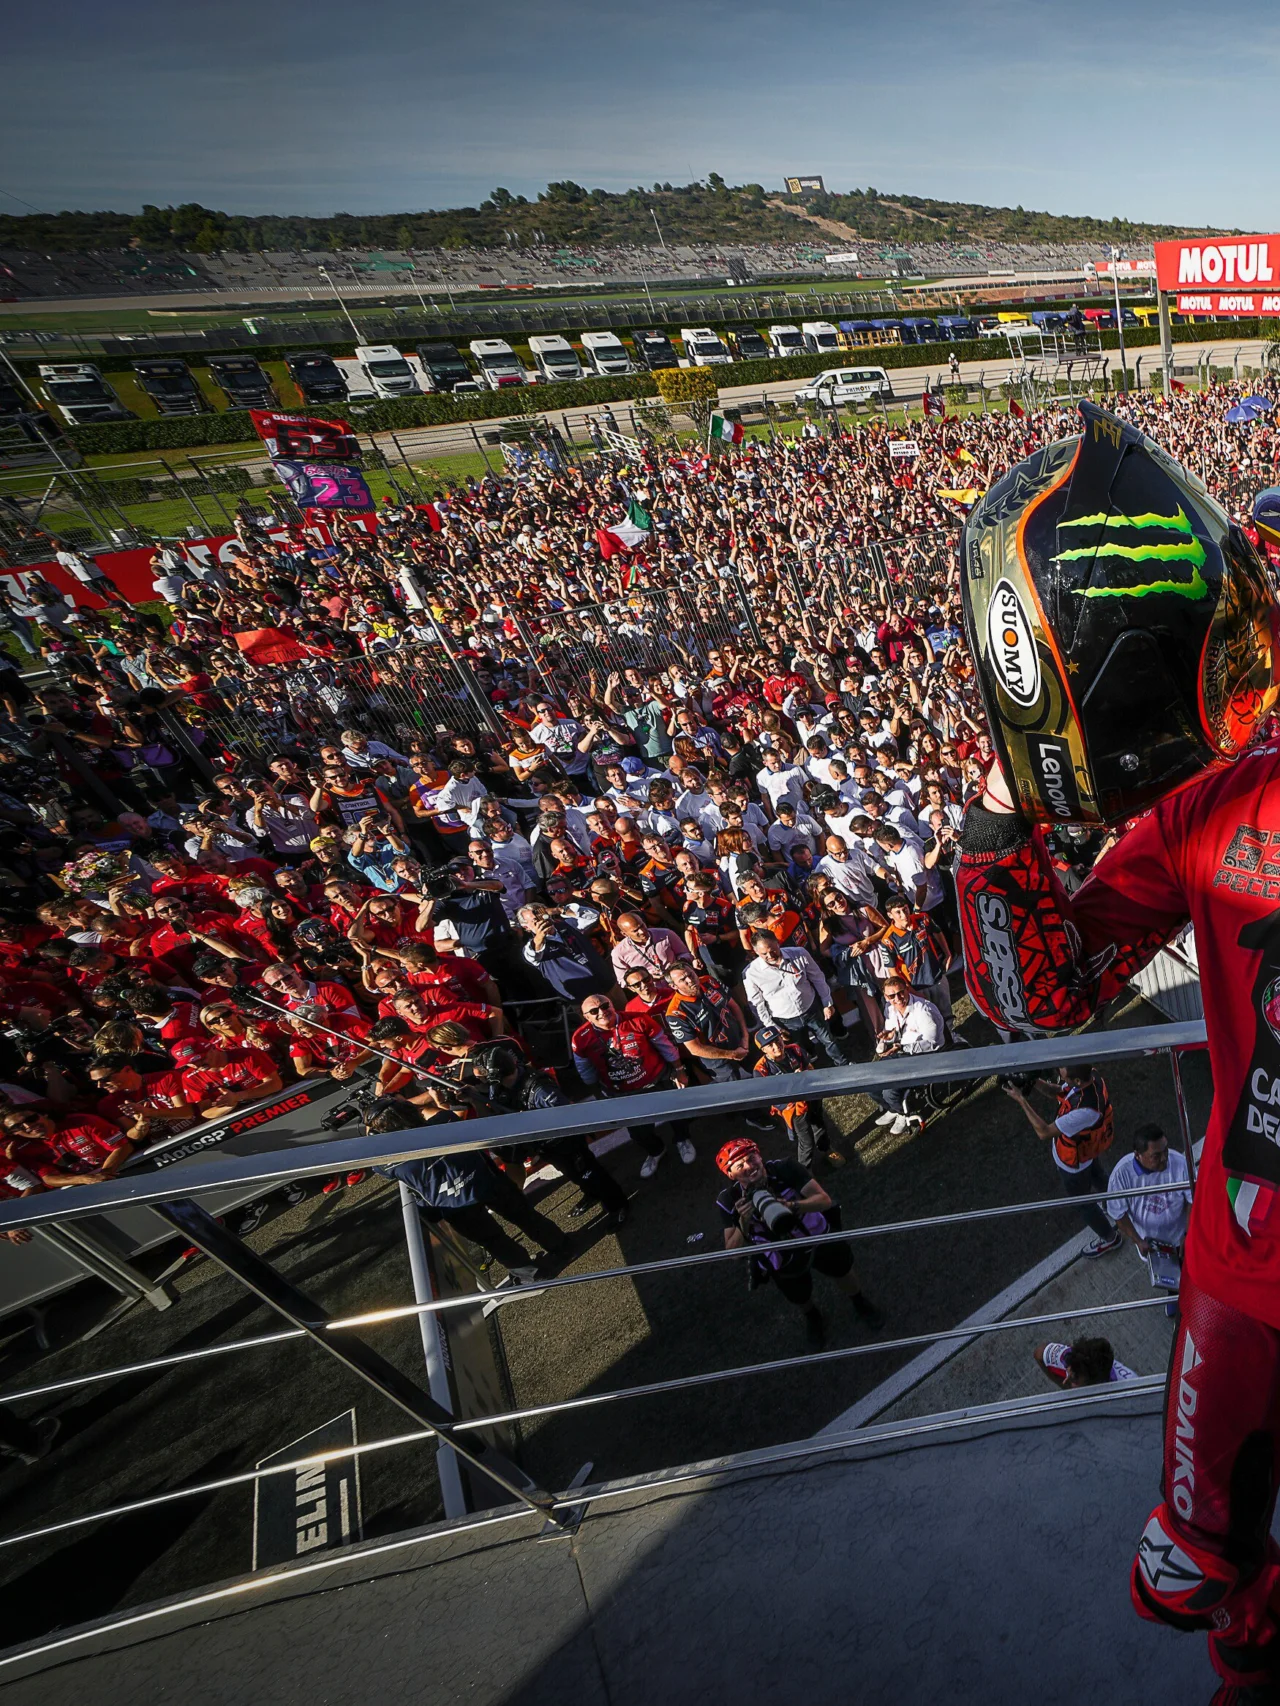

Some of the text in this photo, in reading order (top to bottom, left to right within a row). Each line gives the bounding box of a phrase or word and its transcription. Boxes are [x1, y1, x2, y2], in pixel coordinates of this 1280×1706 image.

[1178, 243, 1273, 284] MOTUL
[1181, 295, 1212, 310] MOTUL
[1219, 296, 1254, 311] MOTUL
[277, 424, 349, 456] 63
[310, 477, 369, 507] 23
[1001, 593, 1025, 694] SUOMY
[1038, 742, 1071, 818] Lenovo
[230, 1092, 312, 1134] PREMIER
